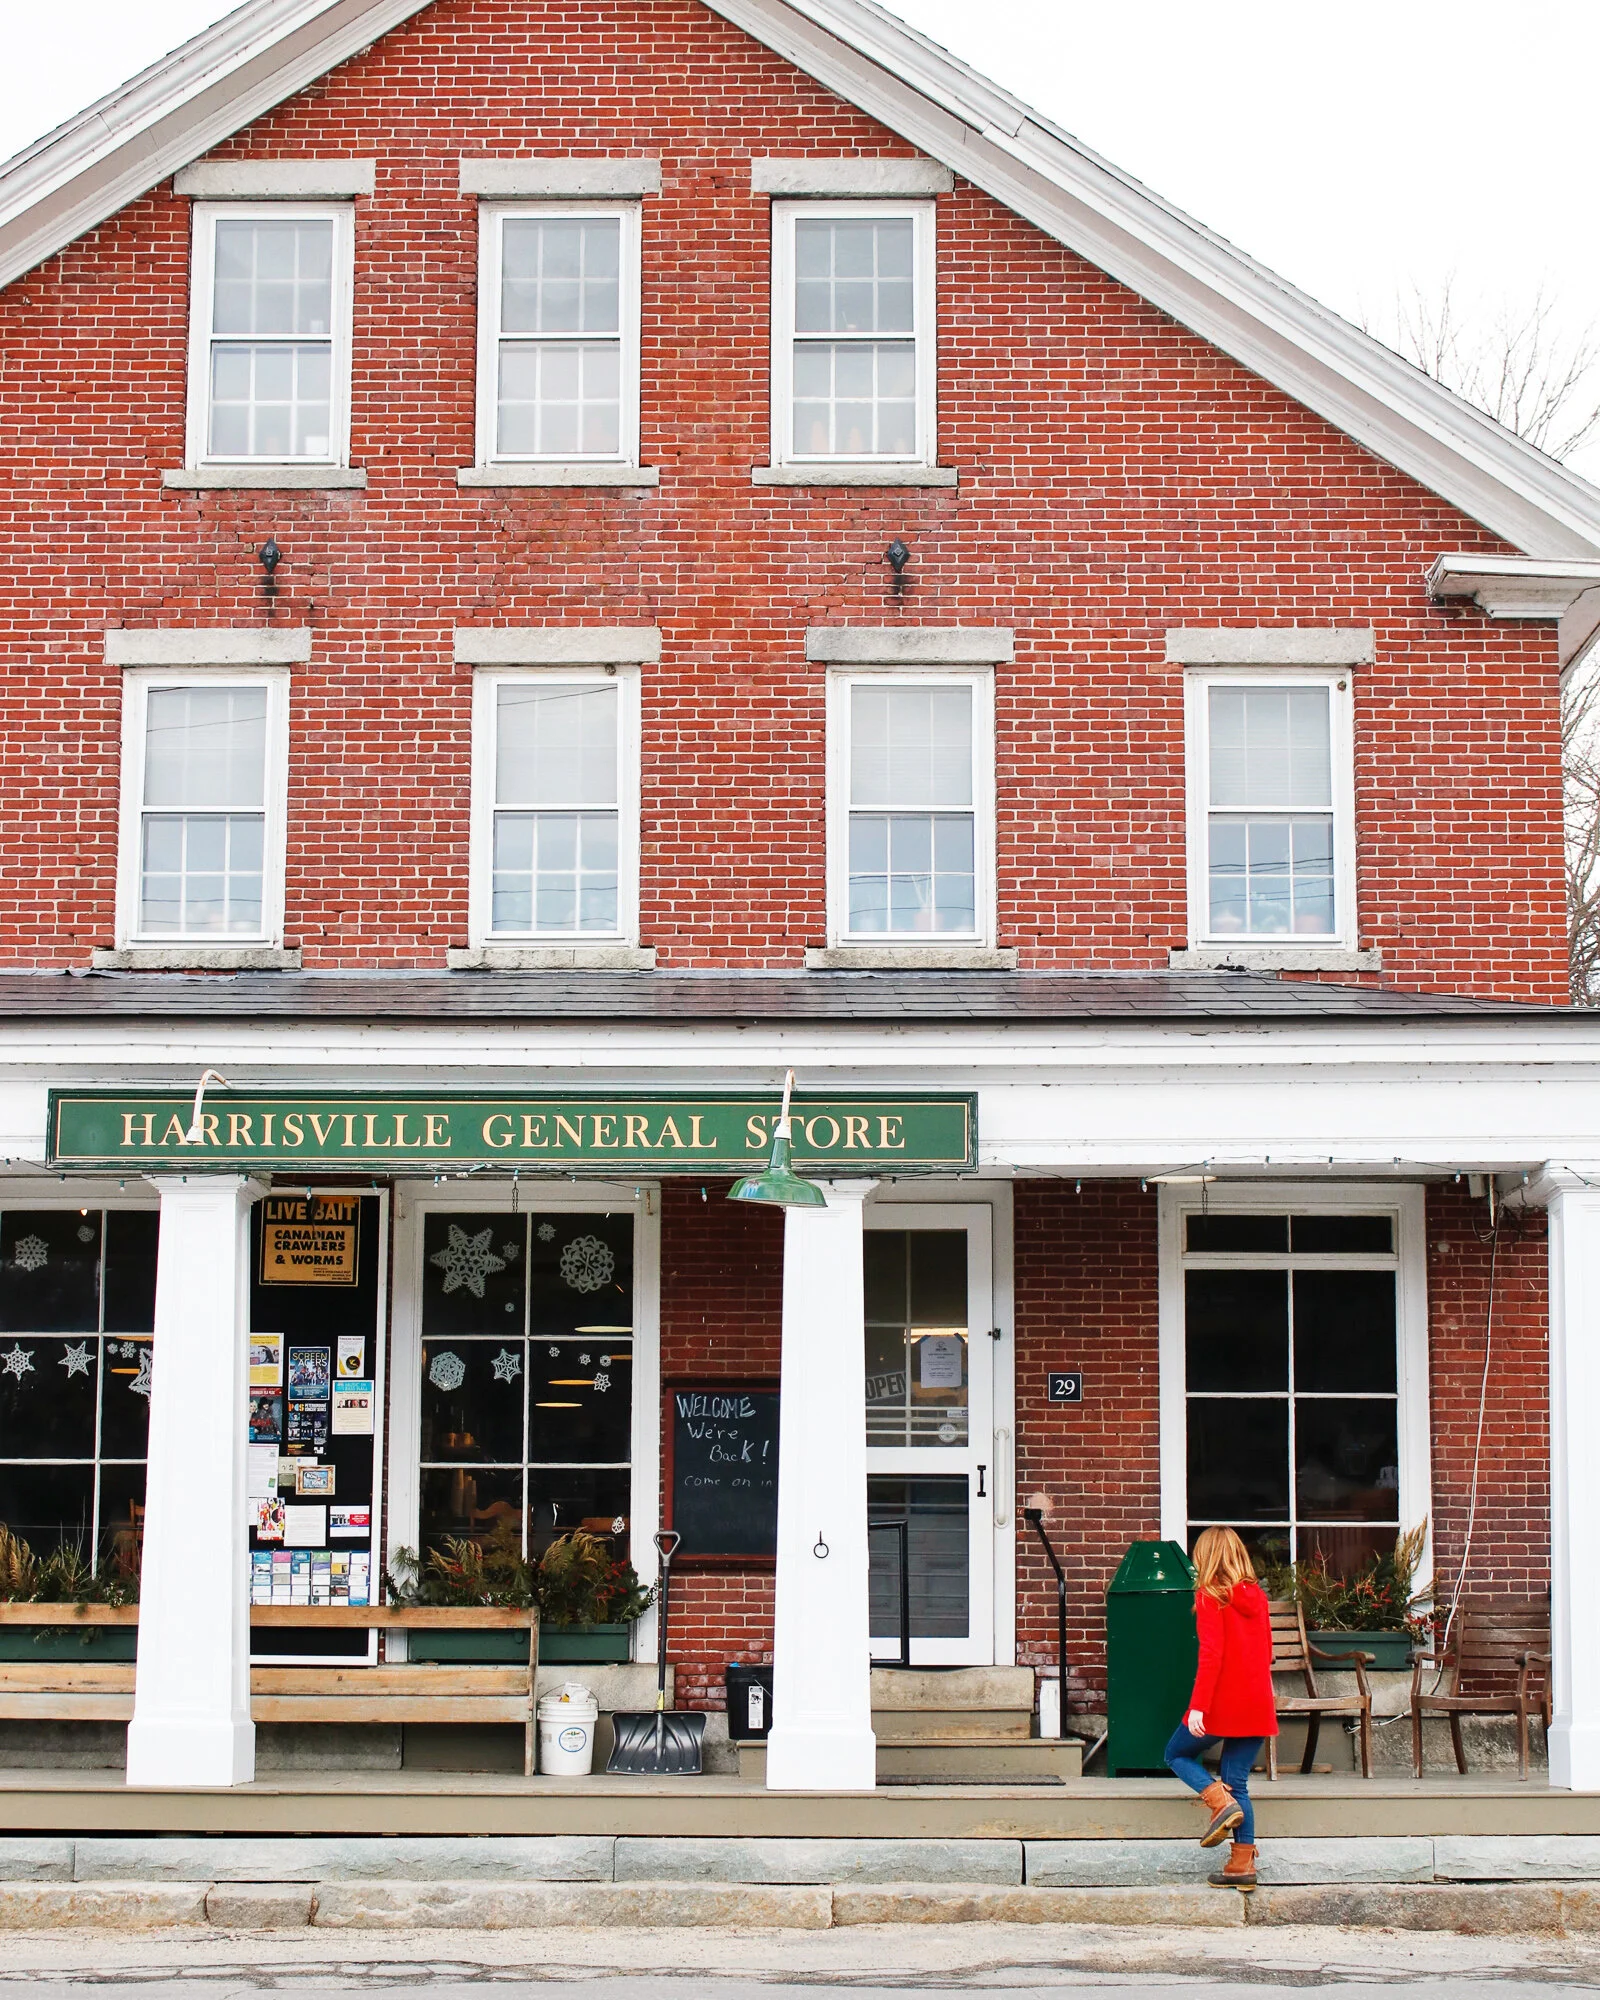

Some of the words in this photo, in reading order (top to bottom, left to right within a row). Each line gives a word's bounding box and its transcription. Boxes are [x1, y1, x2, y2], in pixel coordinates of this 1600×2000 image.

[119, 1113, 451, 1147] HARRISVILLE
[482, 1113, 717, 1149] GENERAL
[266, 1202, 307, 1220] LIVE
[314, 1202, 356, 1221] BAIT
[274, 1230, 345, 1240] CANADIAN
[274, 1241, 346, 1251] CRAWLERS
[275, 1255, 286, 1265] &
[291, 1255, 344, 1265] WORMS
[292, 1352, 328, 1361] SCREEN
[865, 1373, 906, 1400] OPEN
[1055, 1379, 1076, 1395] 29
[676, 1394, 756, 1419] WELCOME
[687, 1422, 738, 1439] We're
[732, 1478, 751, 1487] on
[761, 1479, 773, 1487] in
